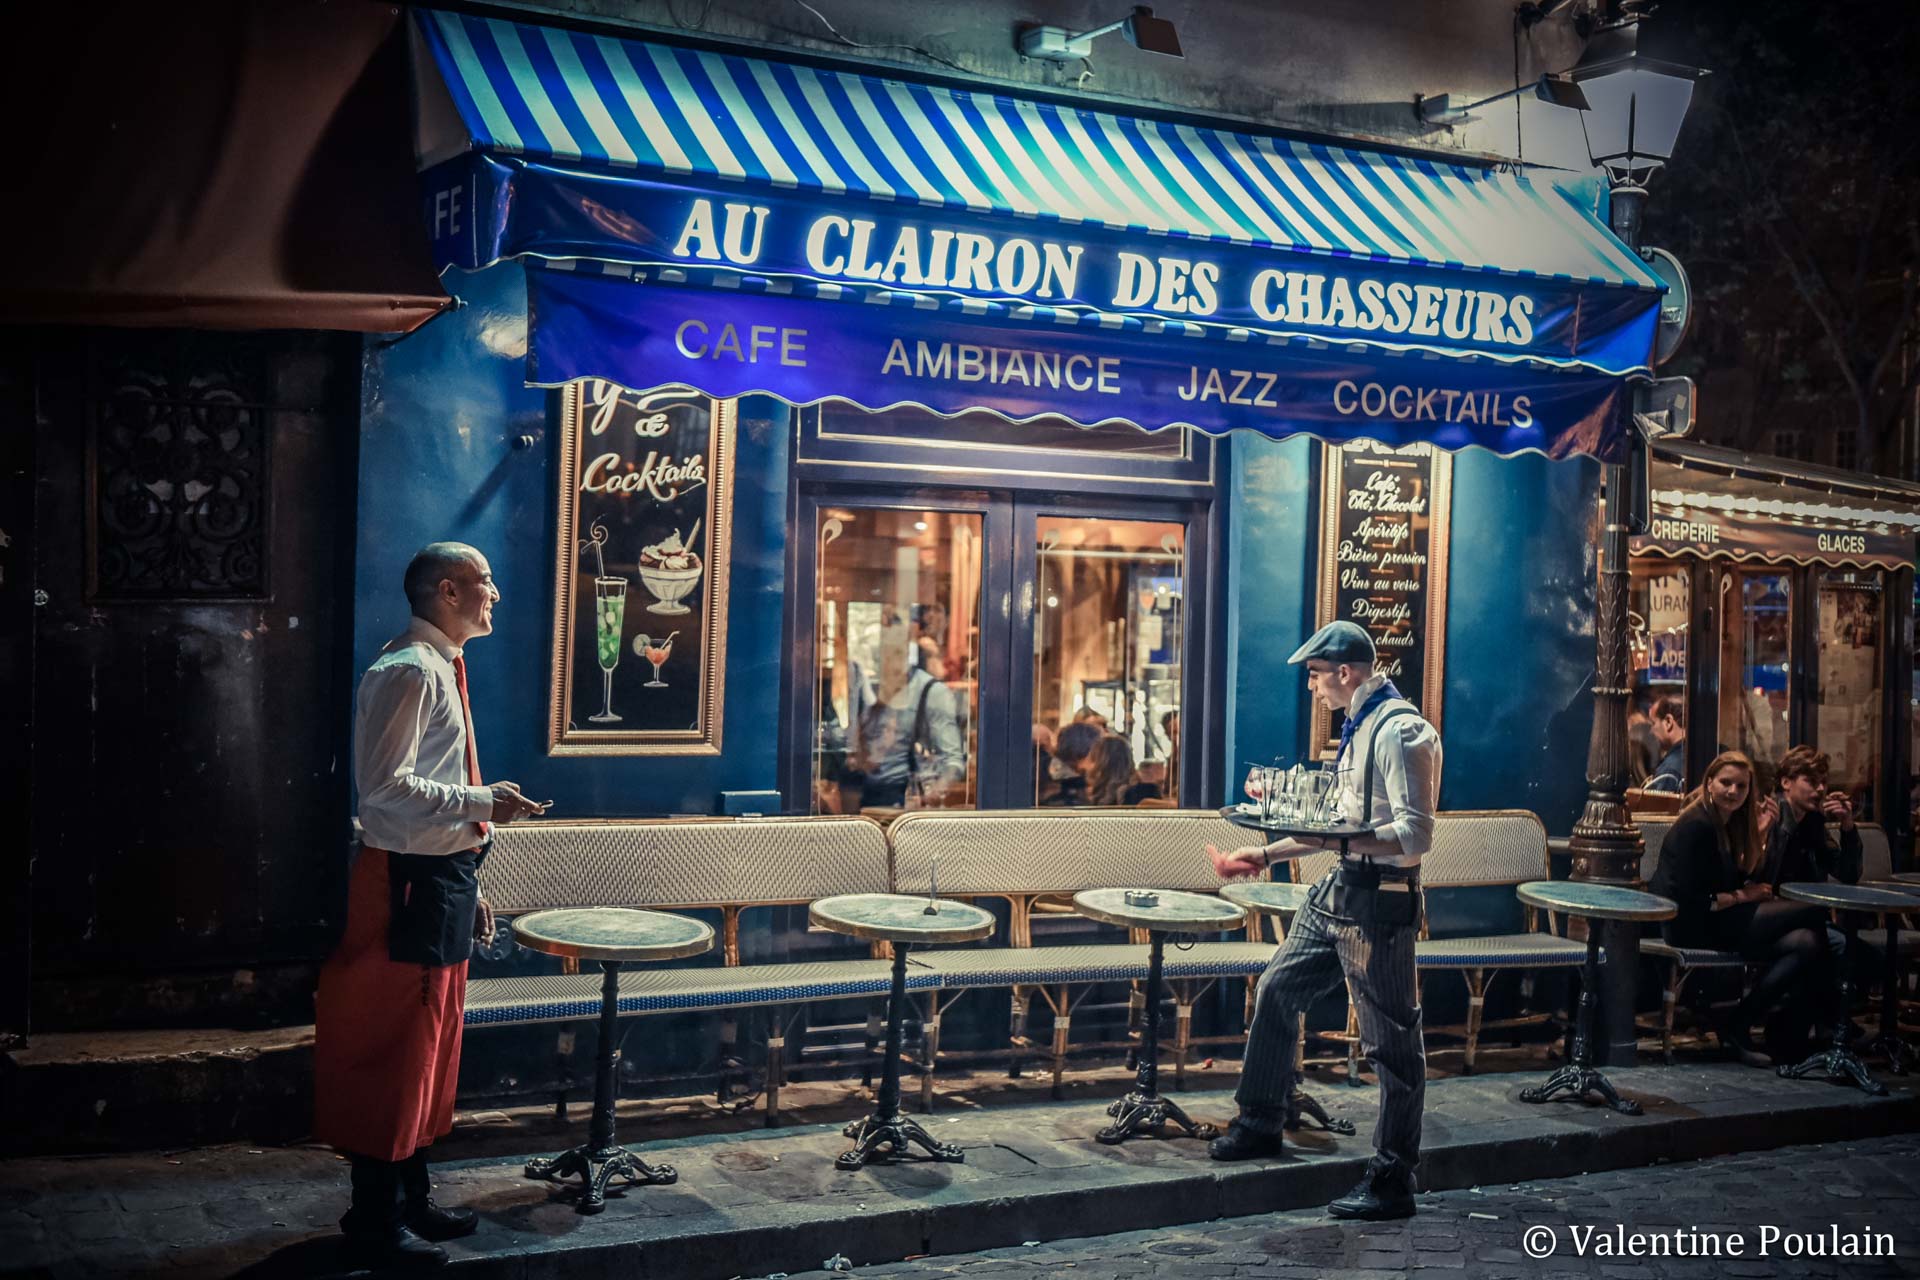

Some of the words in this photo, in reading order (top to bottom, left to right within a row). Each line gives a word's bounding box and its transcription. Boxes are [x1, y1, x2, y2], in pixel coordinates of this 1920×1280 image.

[432, 185, 462, 239] FE
[672, 198, 770, 265] AU
[806, 215, 1084, 299] CLAIRON
[1112, 252, 1219, 315] DES
[1250, 269, 1534, 345] CHASSEURS
[675, 320, 808, 367] CAFE
[881, 338, 1121, 394] AMBIANCE
[1178, 366, 1278, 407] JAZZ
[1333, 380, 1533, 429] COCKTAILS
[580, 451, 707, 501] Cocktails
[1652, 520, 1720, 544] CREPERIE
[1817, 534, 1865, 554] GLACES
[1378, 552, 1426, 570] pression
[1341, 568, 1370, 589] Vins
[1374, 579, 1390, 590] au
[1352, 598, 1411, 625] Digestifs
[1650, 595, 1687, 612] URA
[1375, 630, 1414, 646] chauds
[1374, 659, 1402, 676] tails
